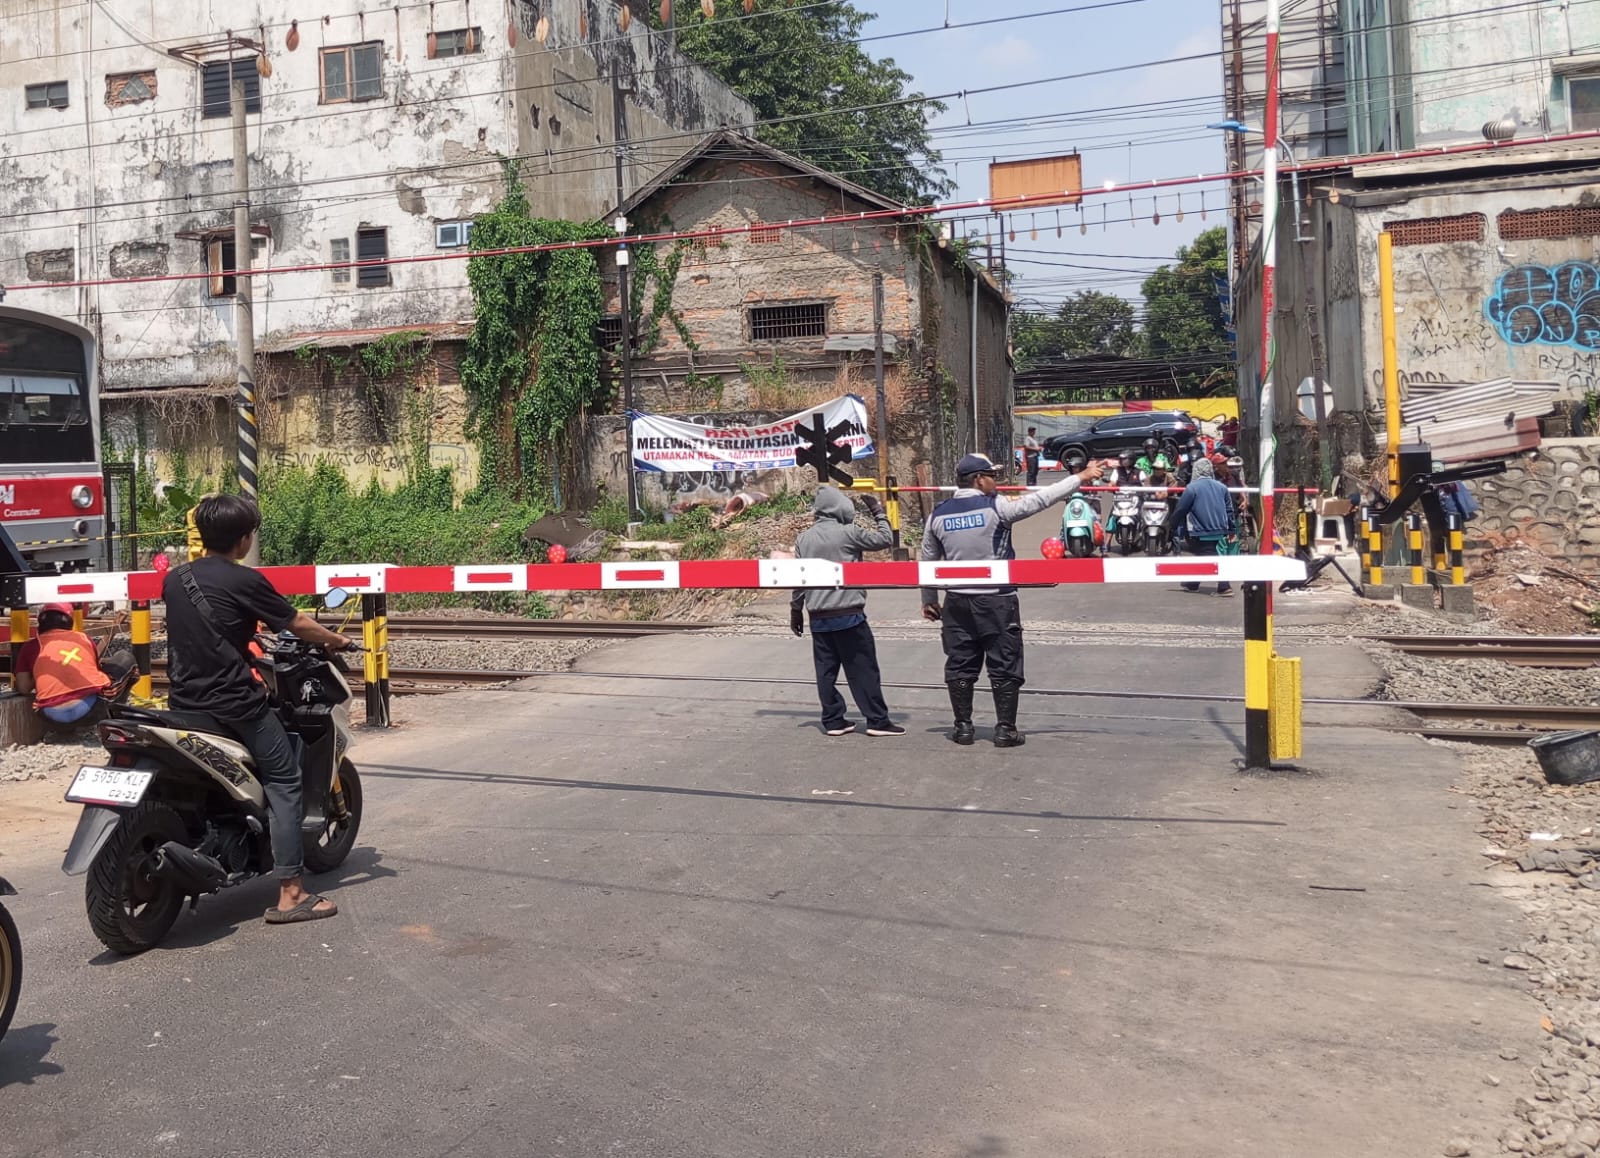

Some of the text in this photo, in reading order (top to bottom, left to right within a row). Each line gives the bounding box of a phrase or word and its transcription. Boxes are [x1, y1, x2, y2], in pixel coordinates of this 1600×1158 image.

[704, 428, 749, 438] HATI
[708, 433, 800, 450] PERLINTASAN
[643, 450, 695, 461] UTAMAKAN
[945, 514, 984, 531] DISHUB
[79, 769, 88, 782] B
